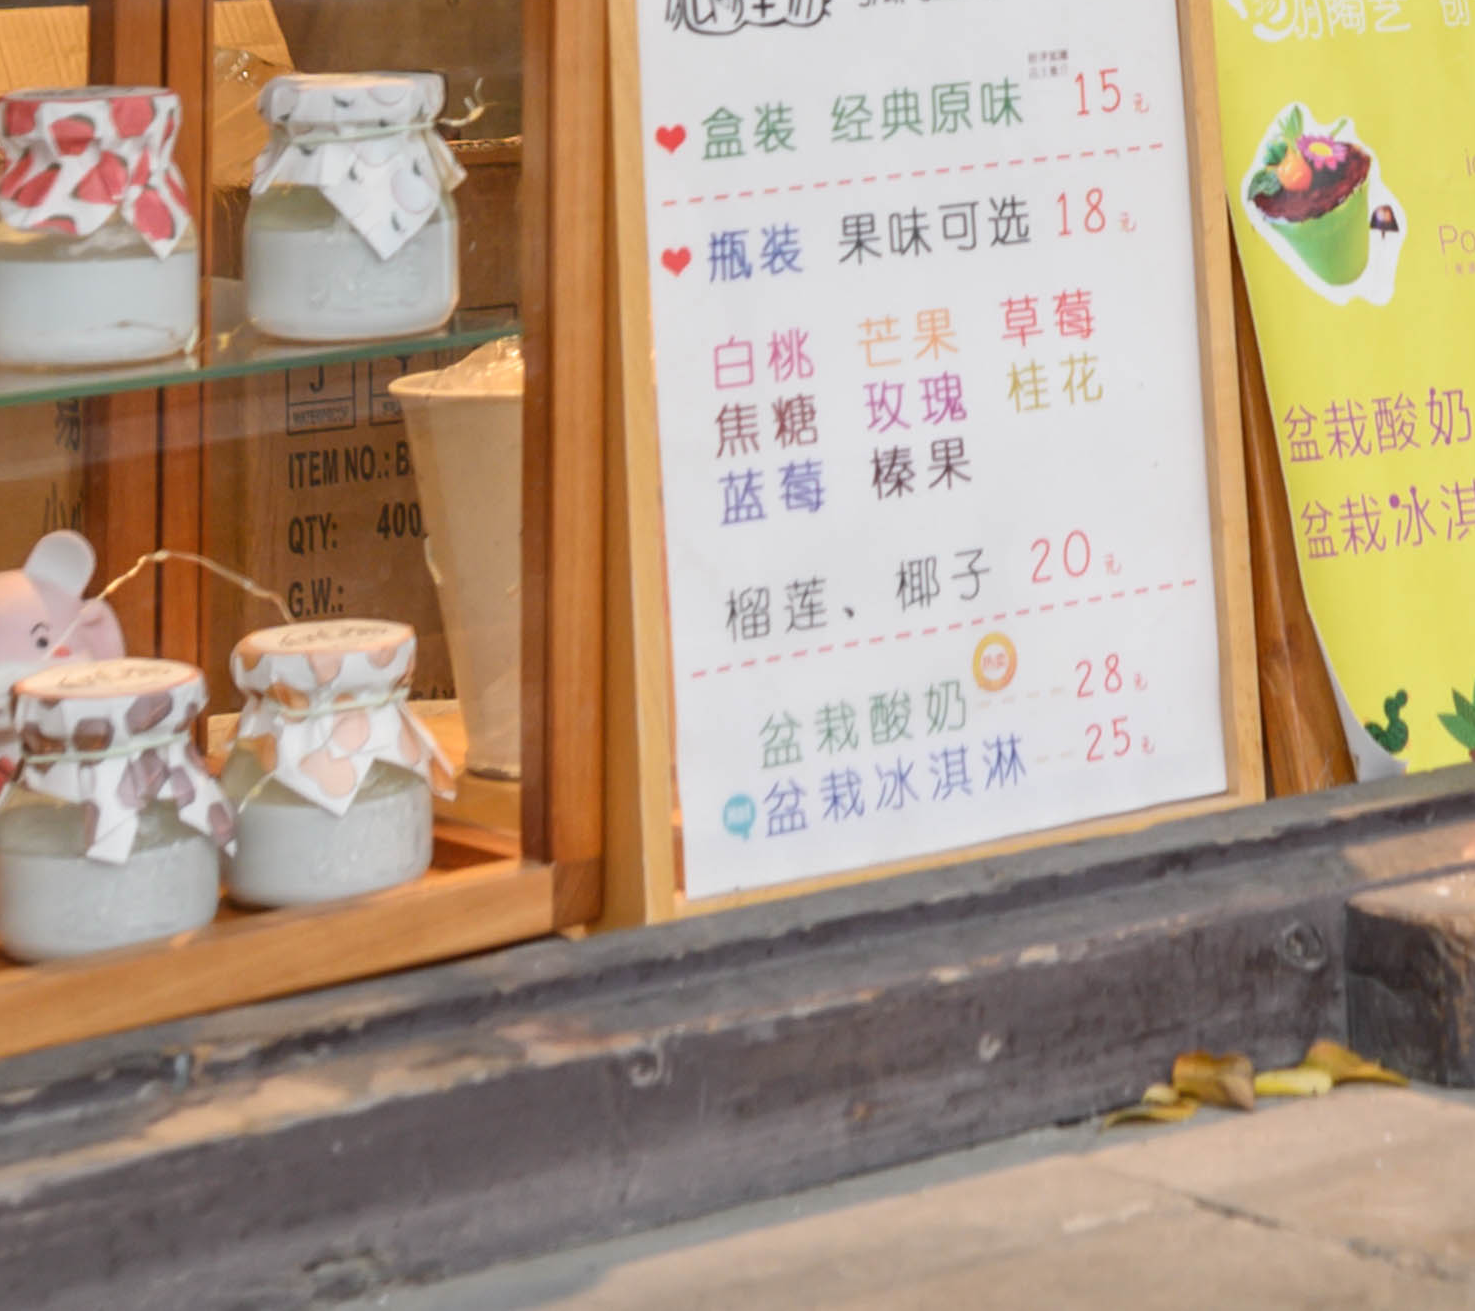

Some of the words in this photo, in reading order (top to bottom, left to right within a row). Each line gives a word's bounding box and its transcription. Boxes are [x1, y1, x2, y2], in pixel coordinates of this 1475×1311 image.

[701, 101, 798, 161] 盒装
[830, 77, 1026, 145] 经典原味
[707, 223, 804, 285] 瓶装
[838, 193, 1033, 267] 果味可选
[712, 326, 815, 392] 白桃
[857, 306, 960, 369] 芒果
[999, 287, 1096, 348] 草莓
[714, 393, 820, 460] 焦糖
[863, 370, 969, 436] 玫瑰
[1006, 350, 1105, 416] 桂花
[1283, 386, 1473, 464] 盆栽酸奶
[288, 450, 339, 491] ITEM
[717, 457, 826, 527] 蓝莓
[870, 435, 973, 504] 榛果
[287, 512, 339, 556] QTY:
[758, 677, 970, 771] 盆栽酸奶
[762, 733, 1027, 838] 盆栽冰淇淋
